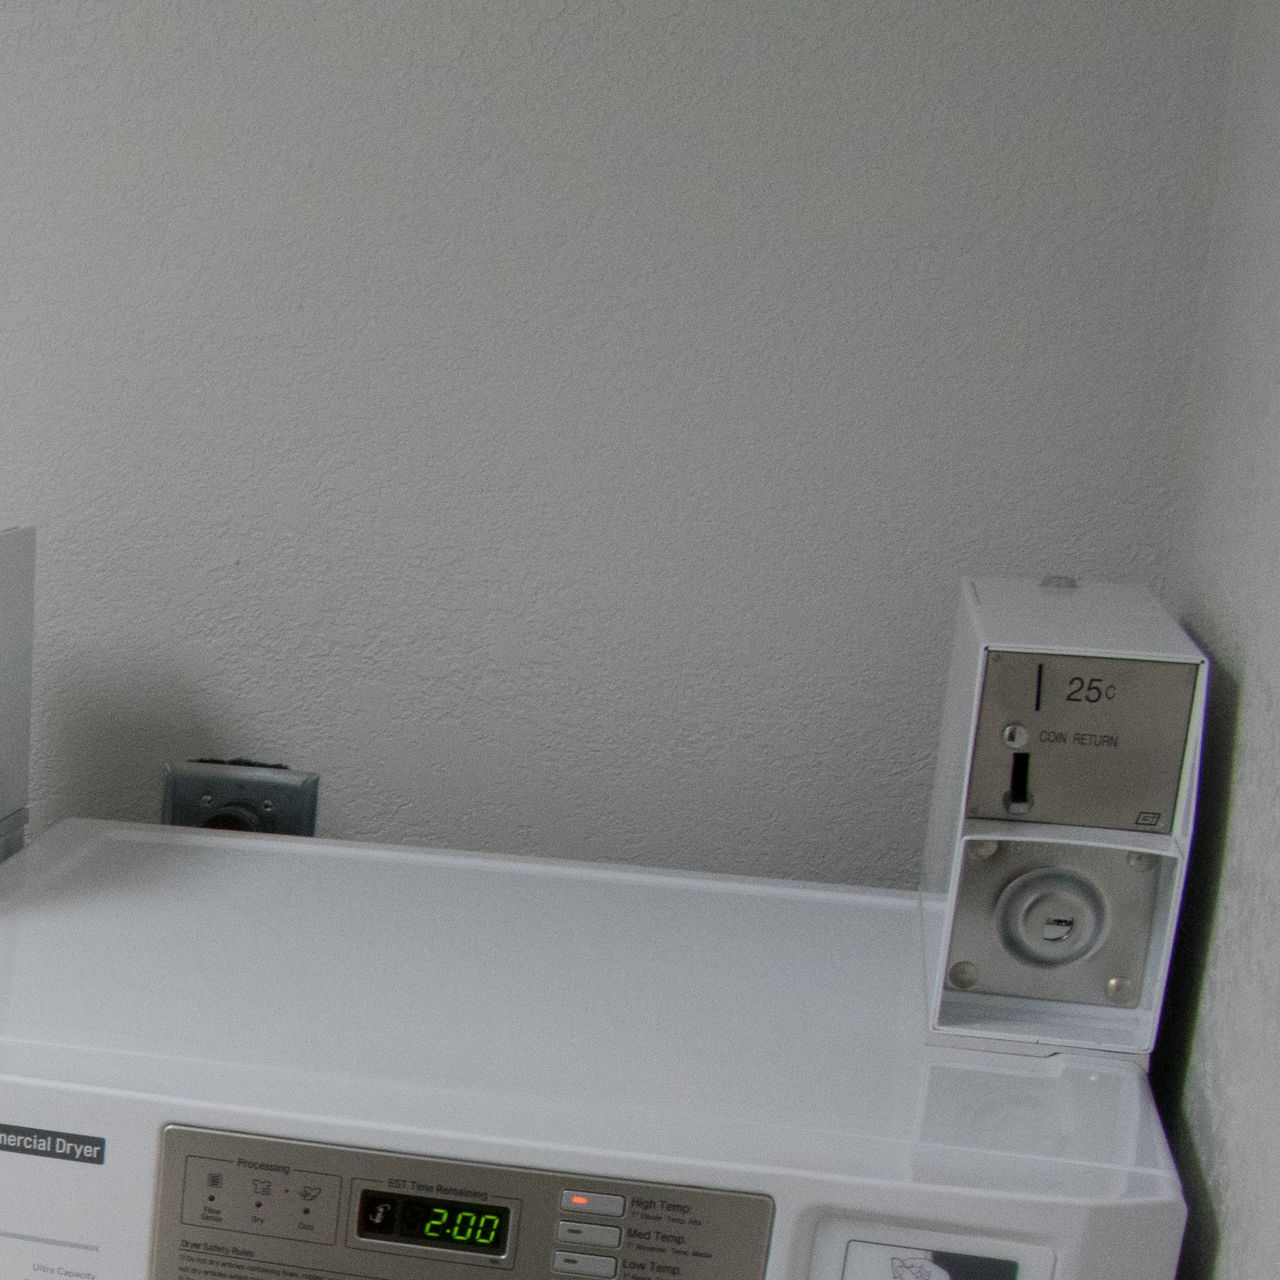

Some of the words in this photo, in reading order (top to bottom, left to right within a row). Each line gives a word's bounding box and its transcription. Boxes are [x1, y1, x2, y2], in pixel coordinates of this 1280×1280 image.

[1040, 730, 1067, 743] COIN
[1073, 733, 1119, 747] RETURN
[55, 1138, 101, 1159] Dryer
[237, 1158, 291, 1176] Processing
[410, 1181, 434, 1193] Time
[436, 1184, 488, 1201] Remaining
[630, 1196, 656, 1211] High
[627, 1228, 651, 1240] Med
[622, 1259, 646, 1271] Low
[57, 1267, 97, 1280] Capacity
